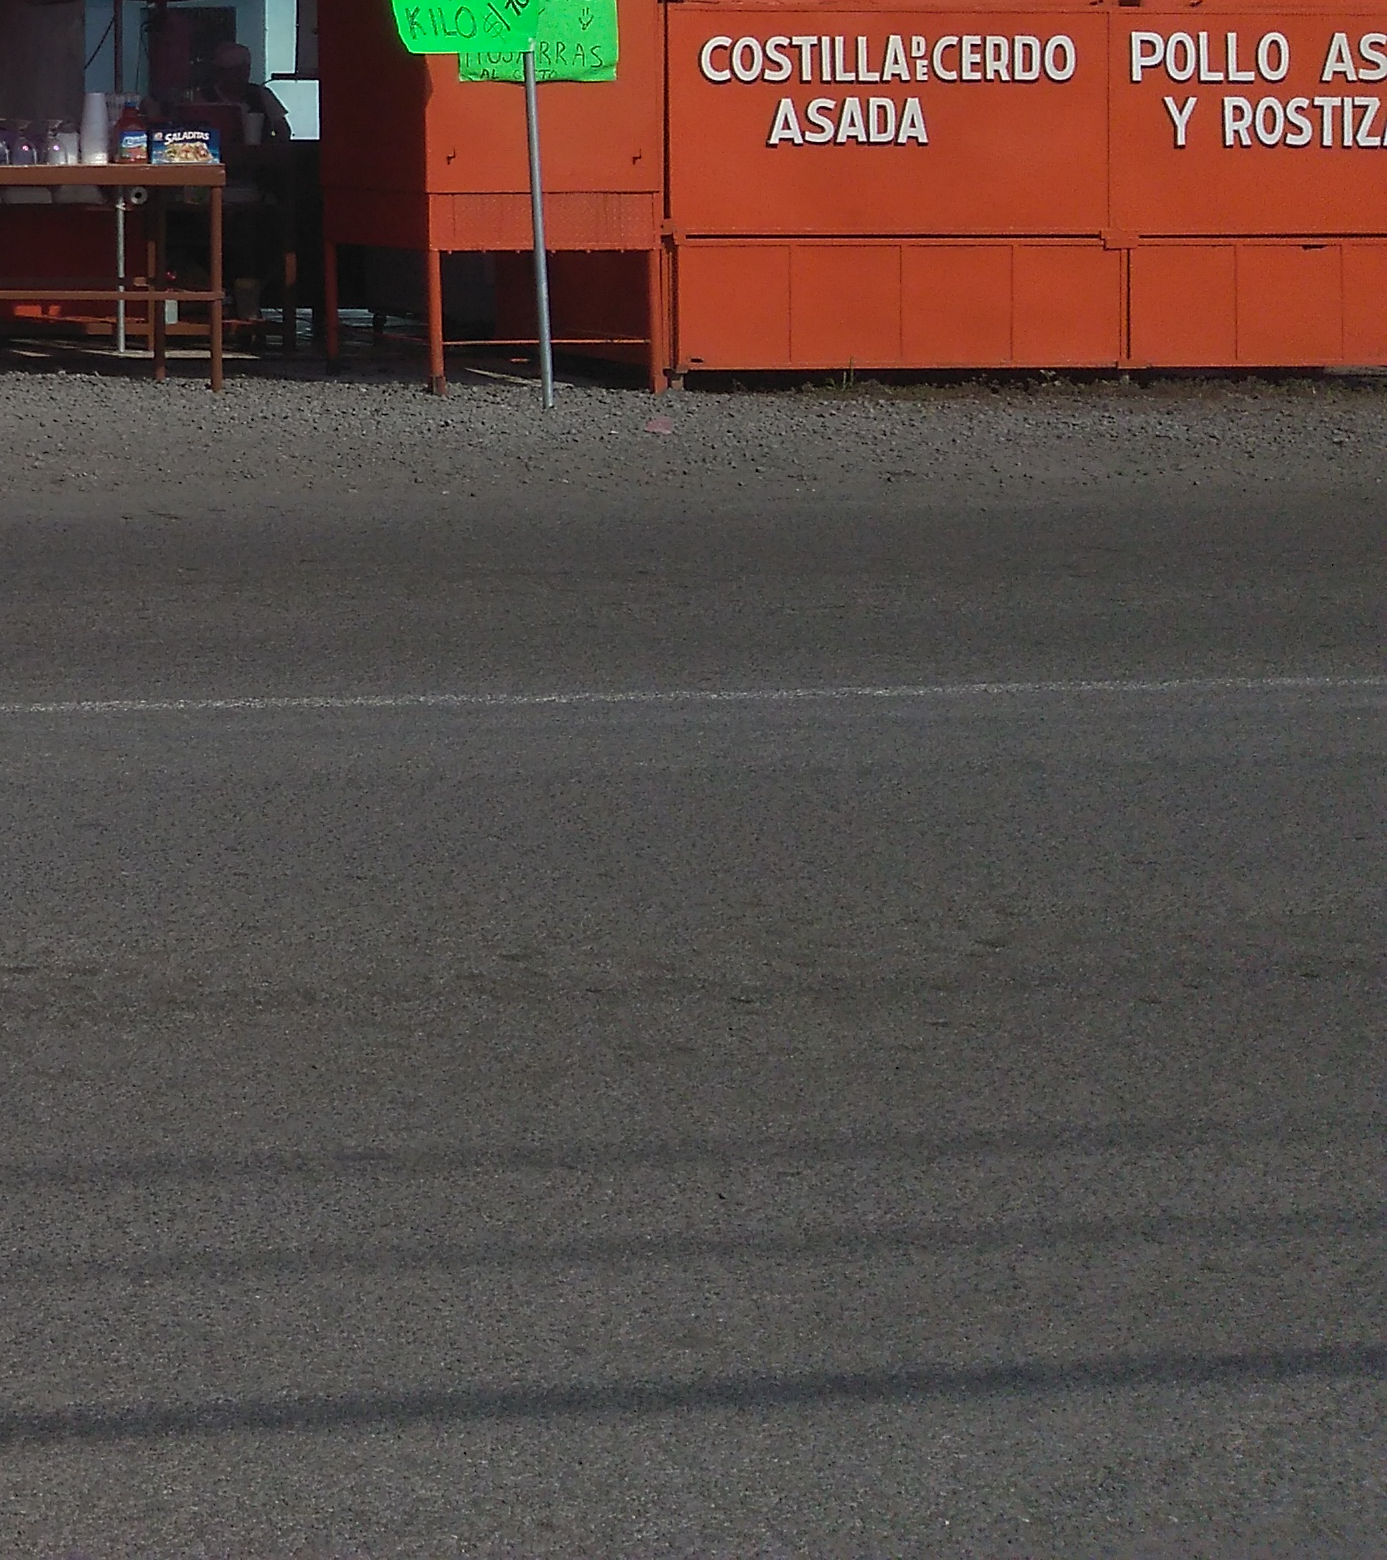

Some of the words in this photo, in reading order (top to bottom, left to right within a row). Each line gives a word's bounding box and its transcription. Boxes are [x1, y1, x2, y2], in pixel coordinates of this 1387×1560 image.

[404, 6, 478, 40] KILO
[701, 34, 911, 82] COSTILLA
[932, 34, 1076, 81] CERDO
[1129, 30, 1289, 82] POLLO
[163, 130, 210, 146] SALADITAS
[768, 96, 928, 145] ASADA
[1165, 96, 1198, 147] Y
[1224, 95, 1387, 147] ROSTIZ
